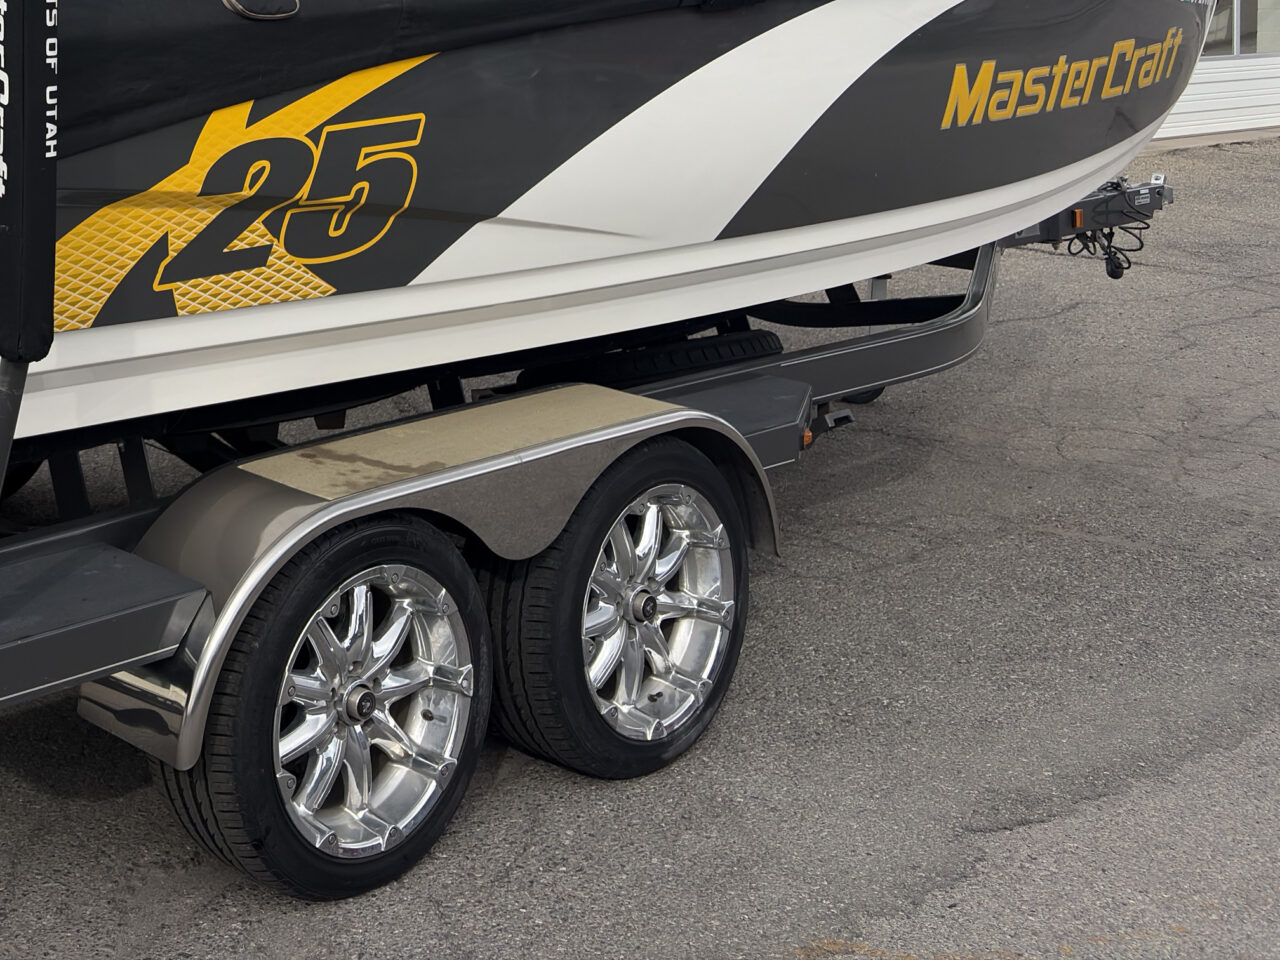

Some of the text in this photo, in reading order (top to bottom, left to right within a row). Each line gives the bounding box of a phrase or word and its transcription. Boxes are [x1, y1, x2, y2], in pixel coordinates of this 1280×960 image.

[45, 38, 58, 74] OF
[940, 27, 1183, 130] MasterCraft
[45, 86, 58, 158] UTAH
[153, 113, 426, 292] 25
